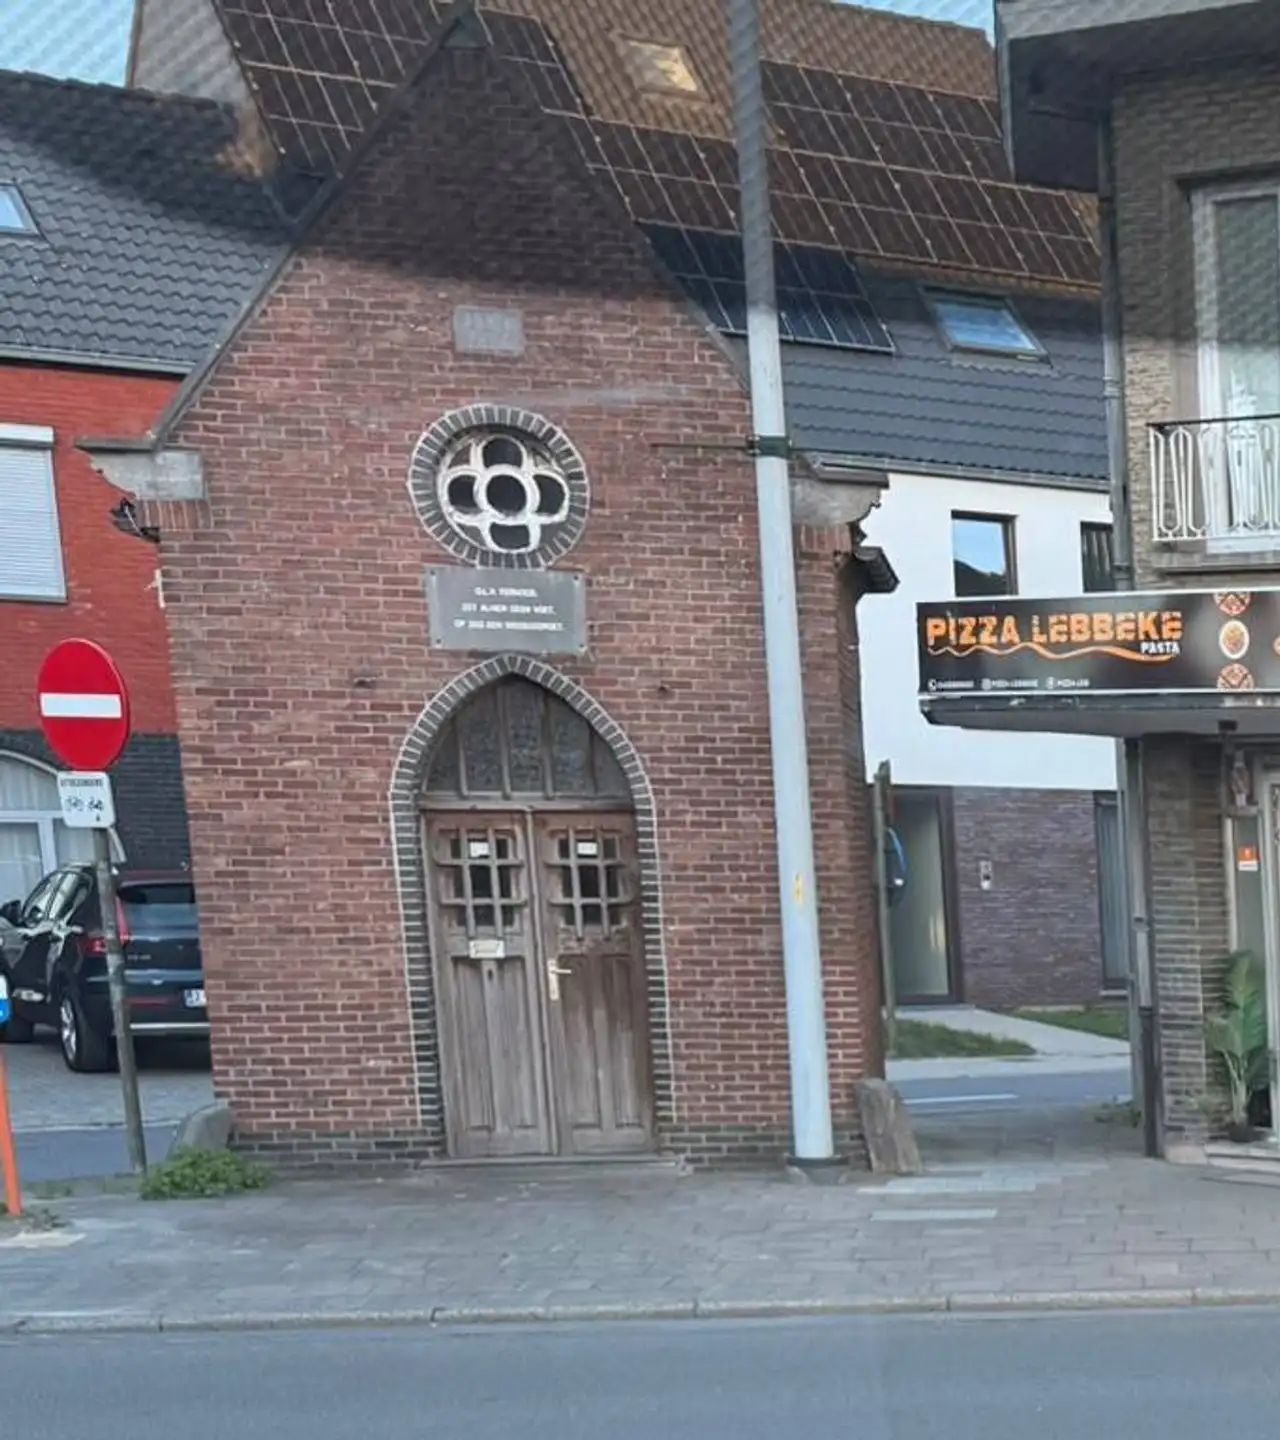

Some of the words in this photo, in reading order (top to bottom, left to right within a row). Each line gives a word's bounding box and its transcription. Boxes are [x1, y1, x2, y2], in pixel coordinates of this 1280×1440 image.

[926, 614, 1020, 645] PIZZA
[1031, 611, 1184, 644] LEBBEKE
[1140, 642, 1180, 655] PASTA
